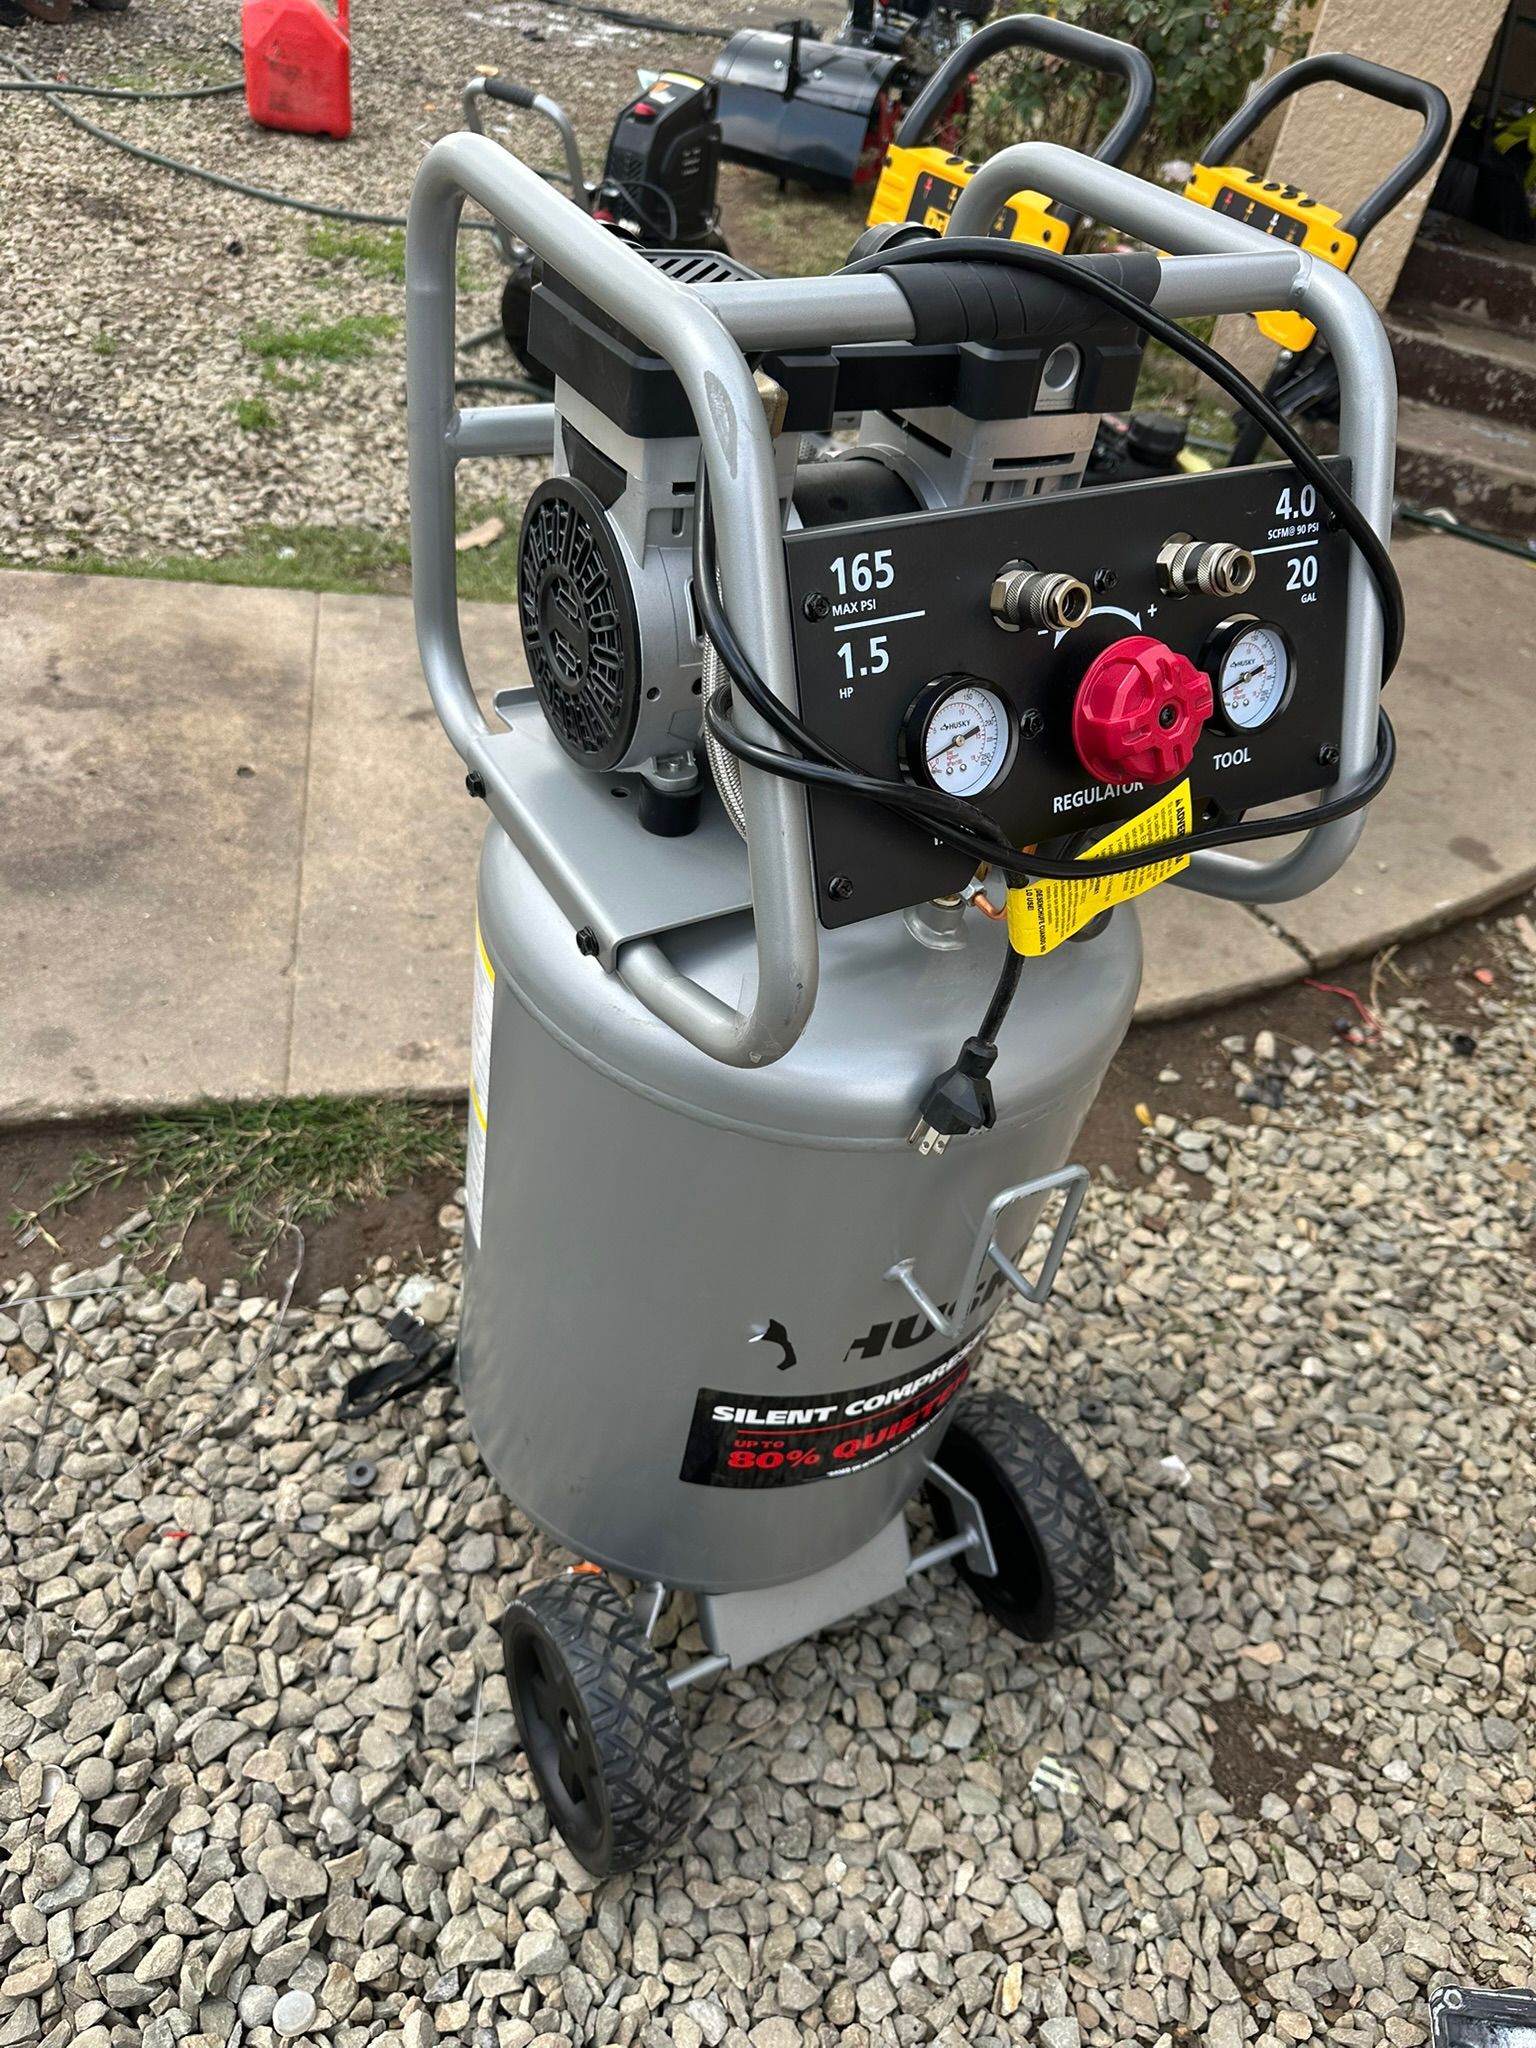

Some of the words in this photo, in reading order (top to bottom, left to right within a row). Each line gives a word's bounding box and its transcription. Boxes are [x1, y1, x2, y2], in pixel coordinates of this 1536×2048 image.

[1275, 484, 1317, 520] 4.0
[1267, 525, 1297, 540] SCFM@
[1296, 524, 1307, 535] 90
[1307, 521, 1320, 534] PSI
[829, 549, 895, 595] 165
[1286, 555, 1319, 591] 20
[832, 601, 859, 617] MAX
[860, 598, 876, 613] PSI
[1300, 592, 1318, 604] GAL
[837, 635, 890, 680] 1.5
[839, 686, 854, 700] HP
[949, 719, 971, 730] HUSKY
[1213, 747, 1252, 771] TOOL
[712, 1405, 838, 1425] SILENT
[734, 1440, 759, 1448] UP
[761, 1440, 785, 1449] TO
[727, 1447, 821, 1469] 80%
